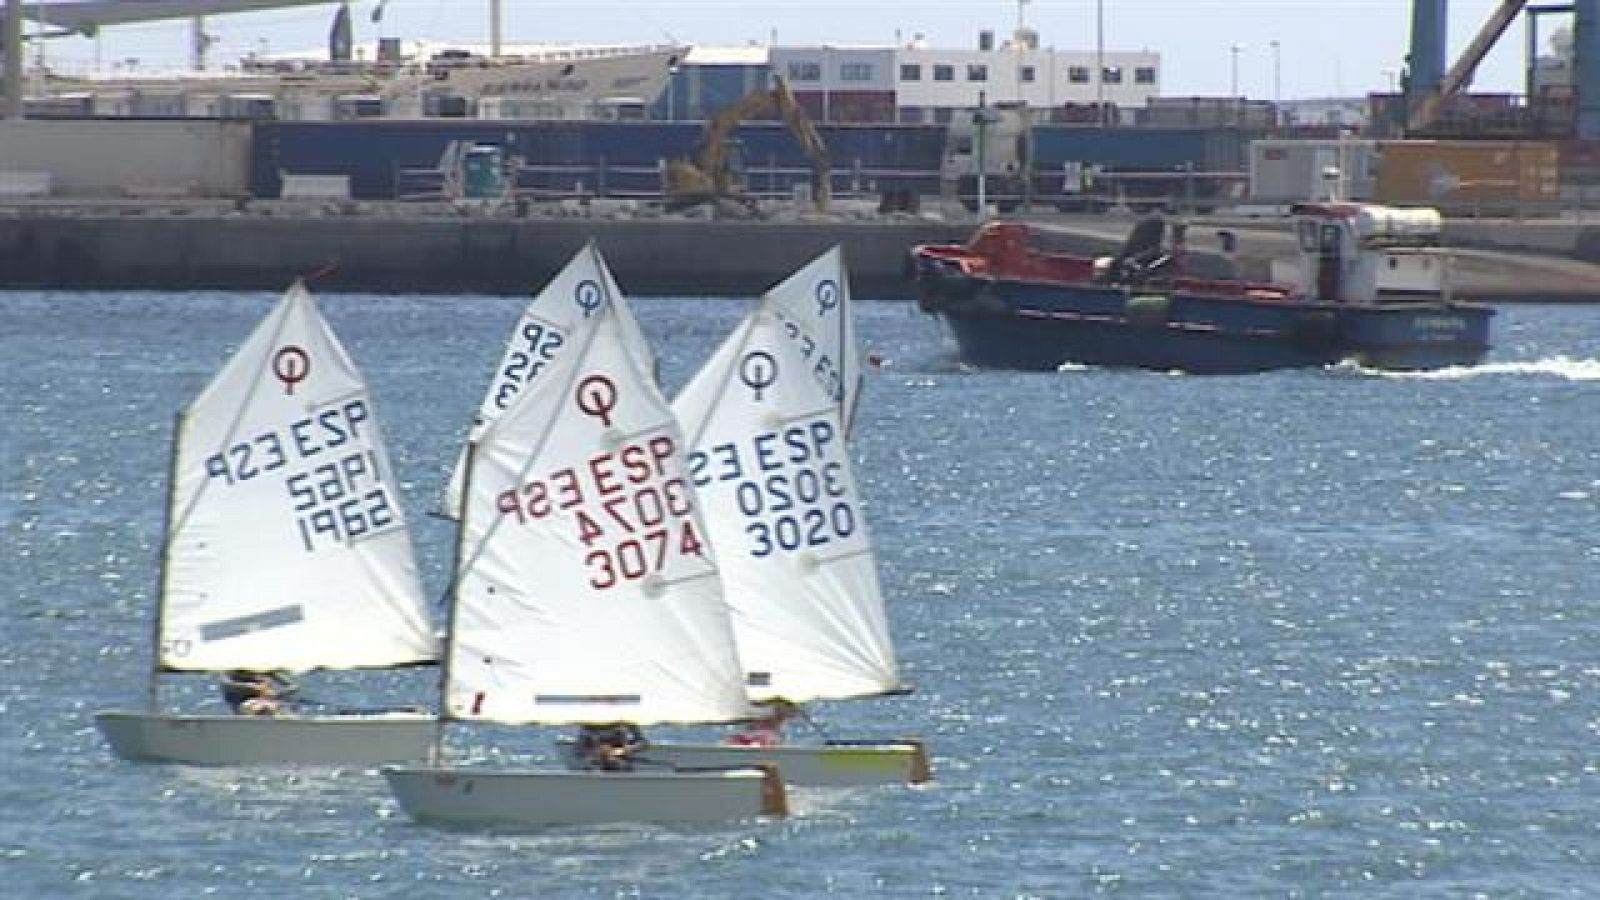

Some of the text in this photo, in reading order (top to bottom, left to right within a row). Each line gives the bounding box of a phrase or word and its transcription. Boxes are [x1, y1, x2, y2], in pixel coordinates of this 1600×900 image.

[289, 399, 368, 457] ESP
[754, 421, 833, 471] ESP
[588, 436, 674, 496] ESP
[296, 488, 392, 552] 1962
[745, 501, 855, 558] 3020
[584, 521, 702, 590] 3074
